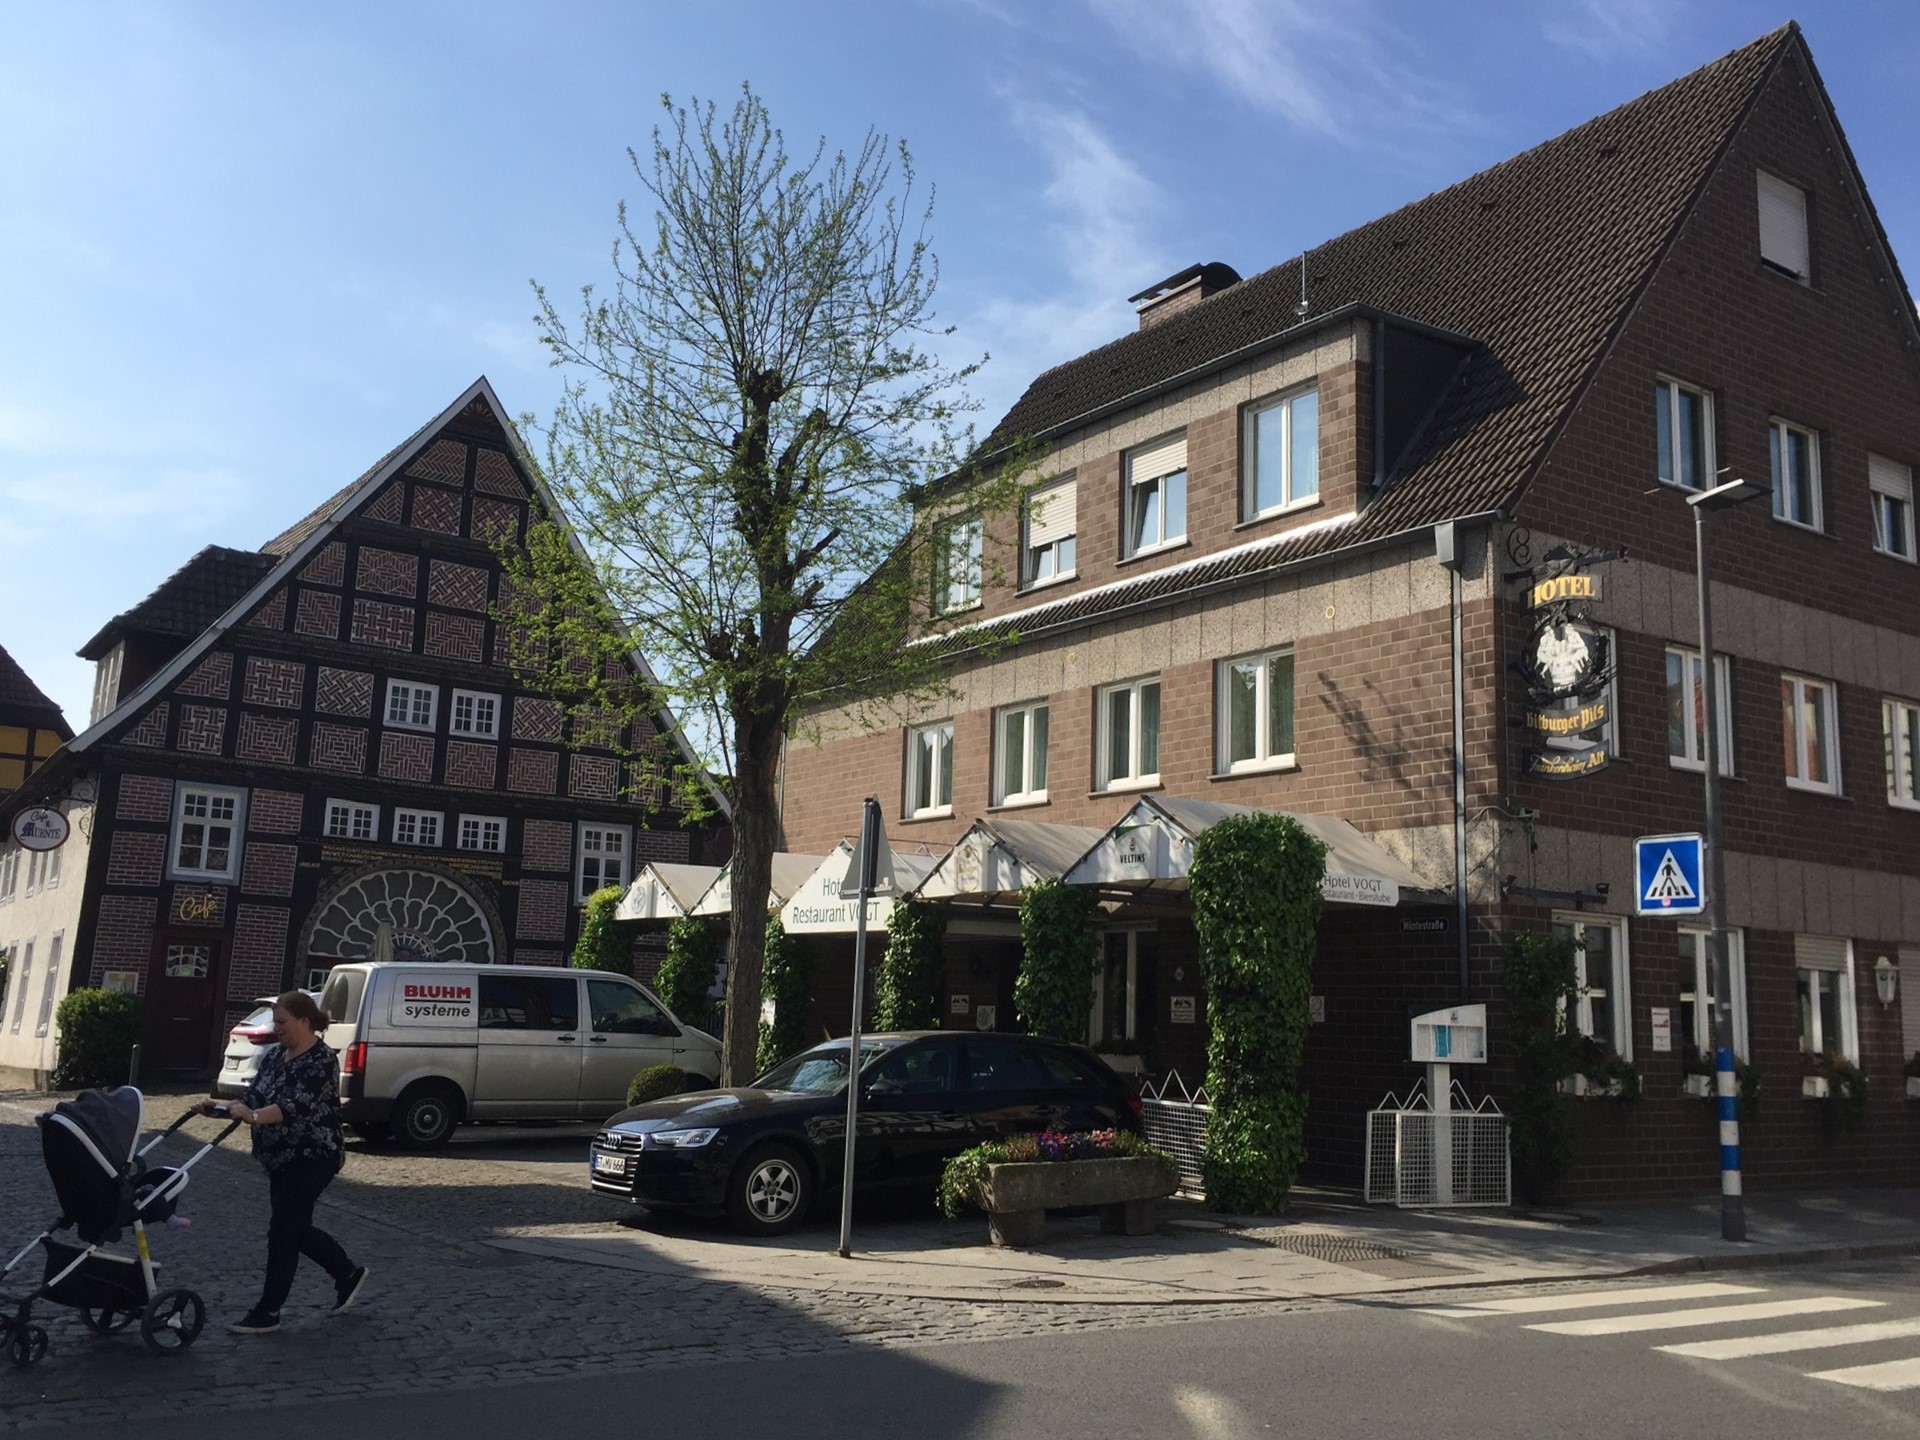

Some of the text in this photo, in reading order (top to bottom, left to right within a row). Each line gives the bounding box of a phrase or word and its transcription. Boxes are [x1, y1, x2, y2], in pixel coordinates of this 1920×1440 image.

[1527, 576, 1595, 609] HOTEL
[1581, 704, 1604, 730] Pils
[1587, 751, 1605, 768] Alt
[1120, 853, 1145, 864] VELTINS
[823, 878, 841, 896] Hot
[1324, 876, 1381, 892] Hotel VOGT
[1321, 889, 1354, 900] estaurant
[793, 905, 845, 924] Restaurant
[405, 985, 471, 999] BLUHM
[405, 1004, 470, 1019] systeme
